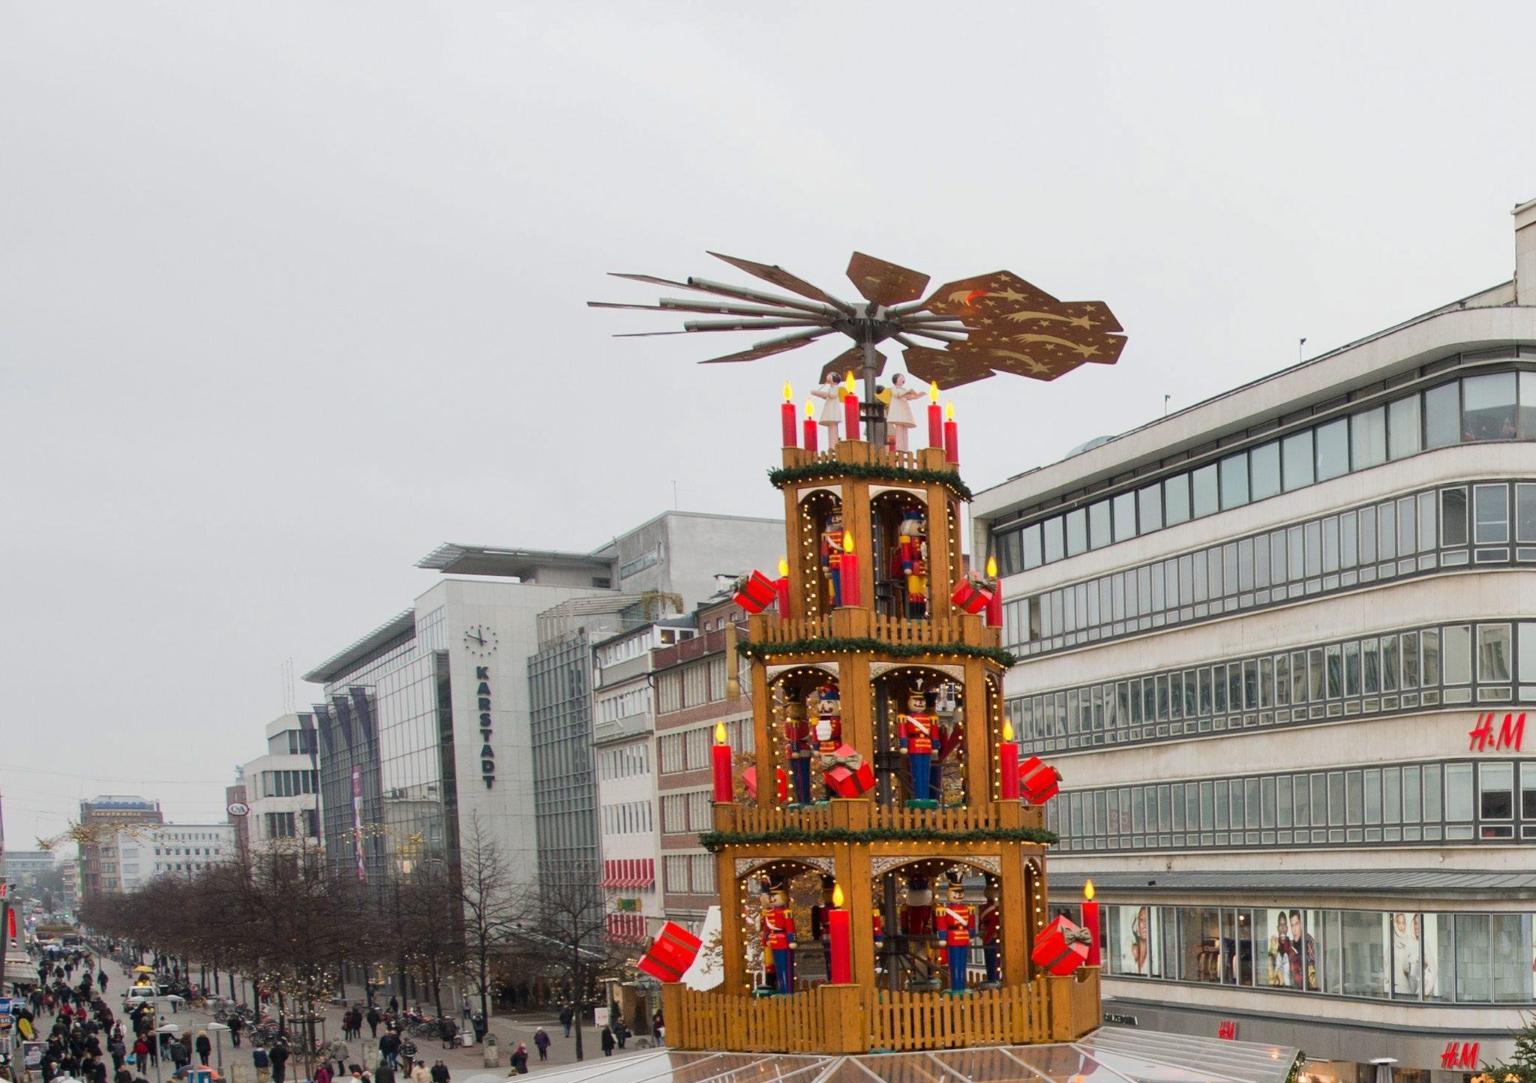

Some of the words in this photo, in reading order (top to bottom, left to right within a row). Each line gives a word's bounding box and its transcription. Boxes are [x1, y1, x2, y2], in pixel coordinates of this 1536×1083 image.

[476, 666, 495, 789] KARSTADT
[1468, 711, 1526, 752] H&M
[1441, 1041, 1479, 1069] H&M
